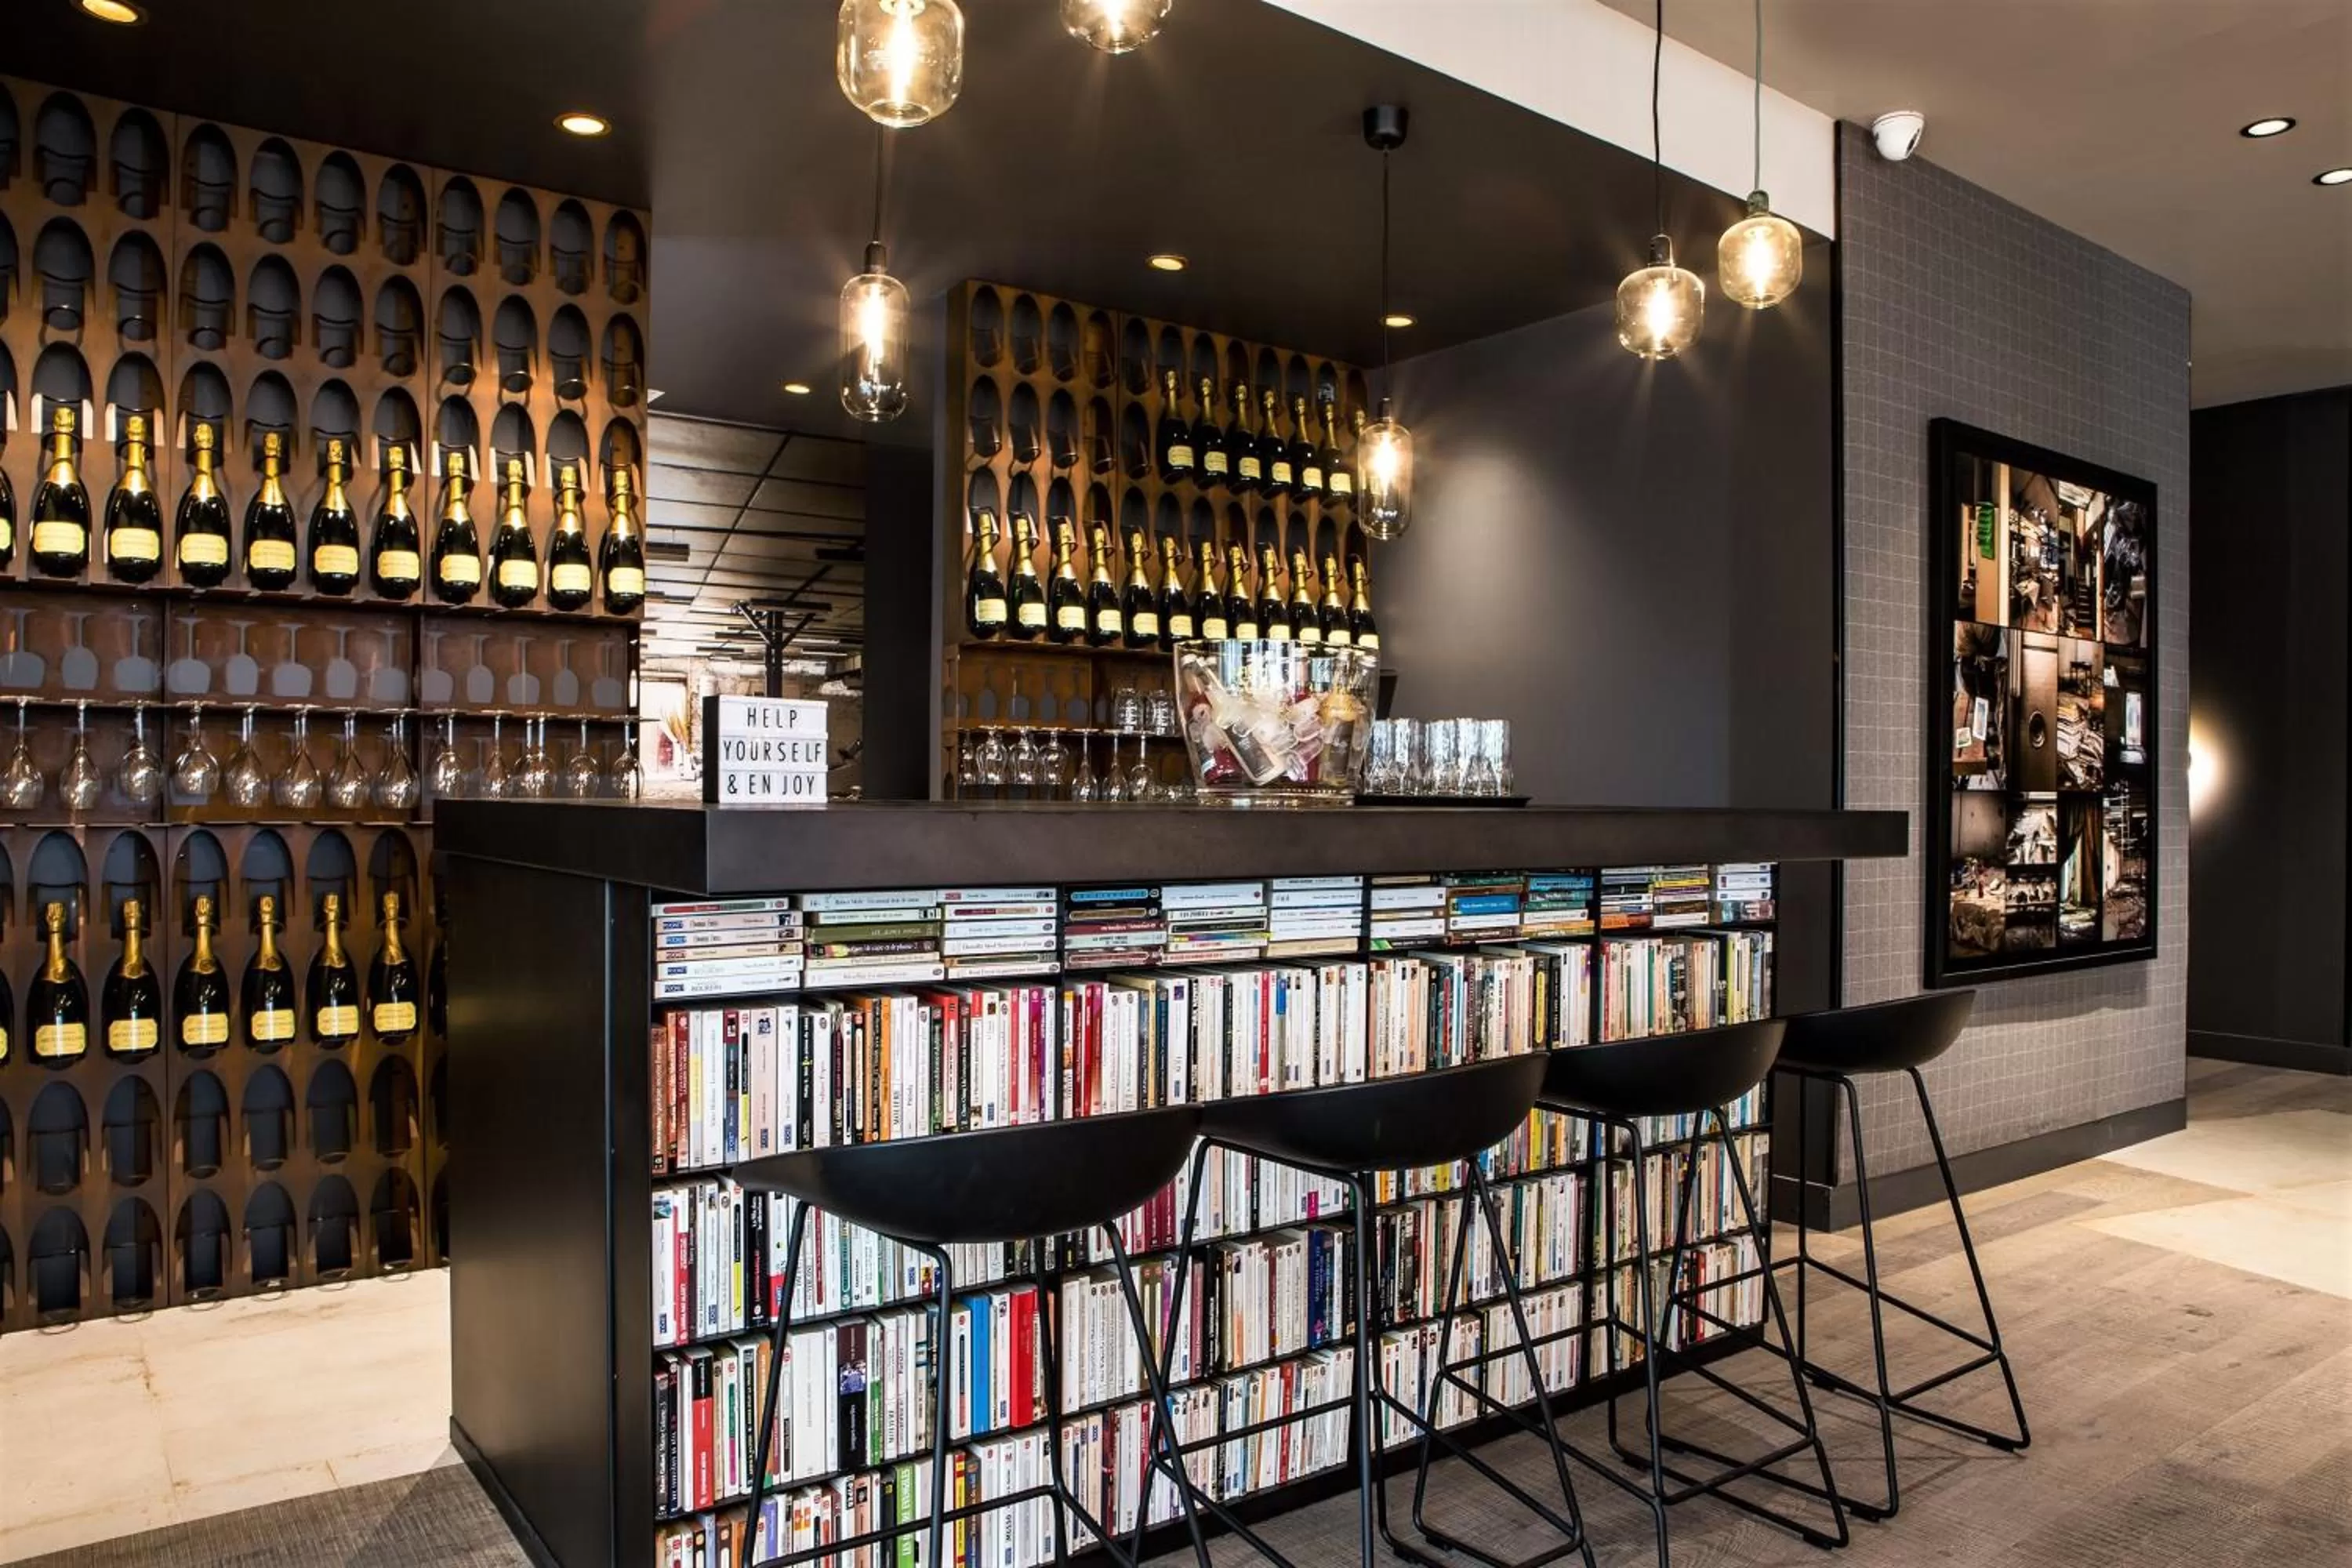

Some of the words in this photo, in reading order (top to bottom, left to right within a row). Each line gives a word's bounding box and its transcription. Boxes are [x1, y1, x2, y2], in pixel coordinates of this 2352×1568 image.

[747, 707, 797, 729] HELP
[723, 740, 822, 763] YOURSELF
[728, 774, 738, 794] &
[749, 774, 815, 795] ENJOY
